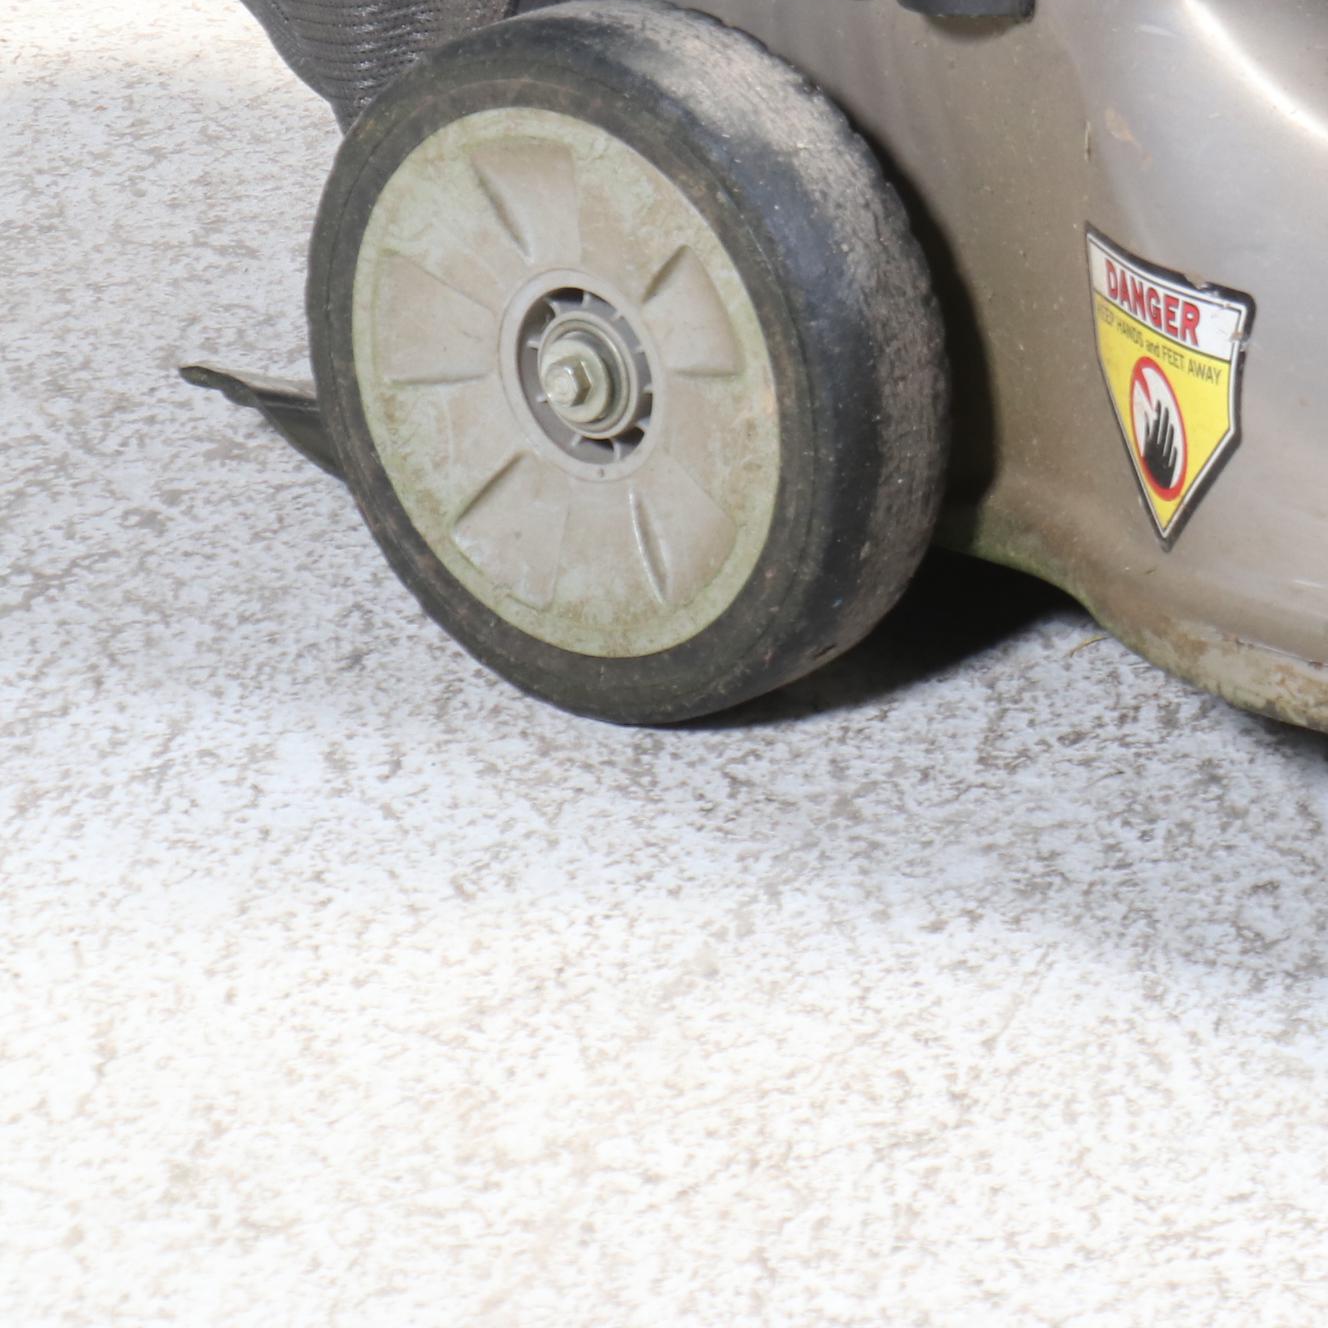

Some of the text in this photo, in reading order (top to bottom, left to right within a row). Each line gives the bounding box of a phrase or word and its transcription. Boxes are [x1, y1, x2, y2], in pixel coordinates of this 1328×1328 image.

[1105, 258, 1200, 347] DANGER
[1116, 320, 1144, 349] HANDS
[1146, 340, 1161, 360] and
[1162, 346, 1185, 370] FEET
[1187, 360, 1222, 386] AWAY
